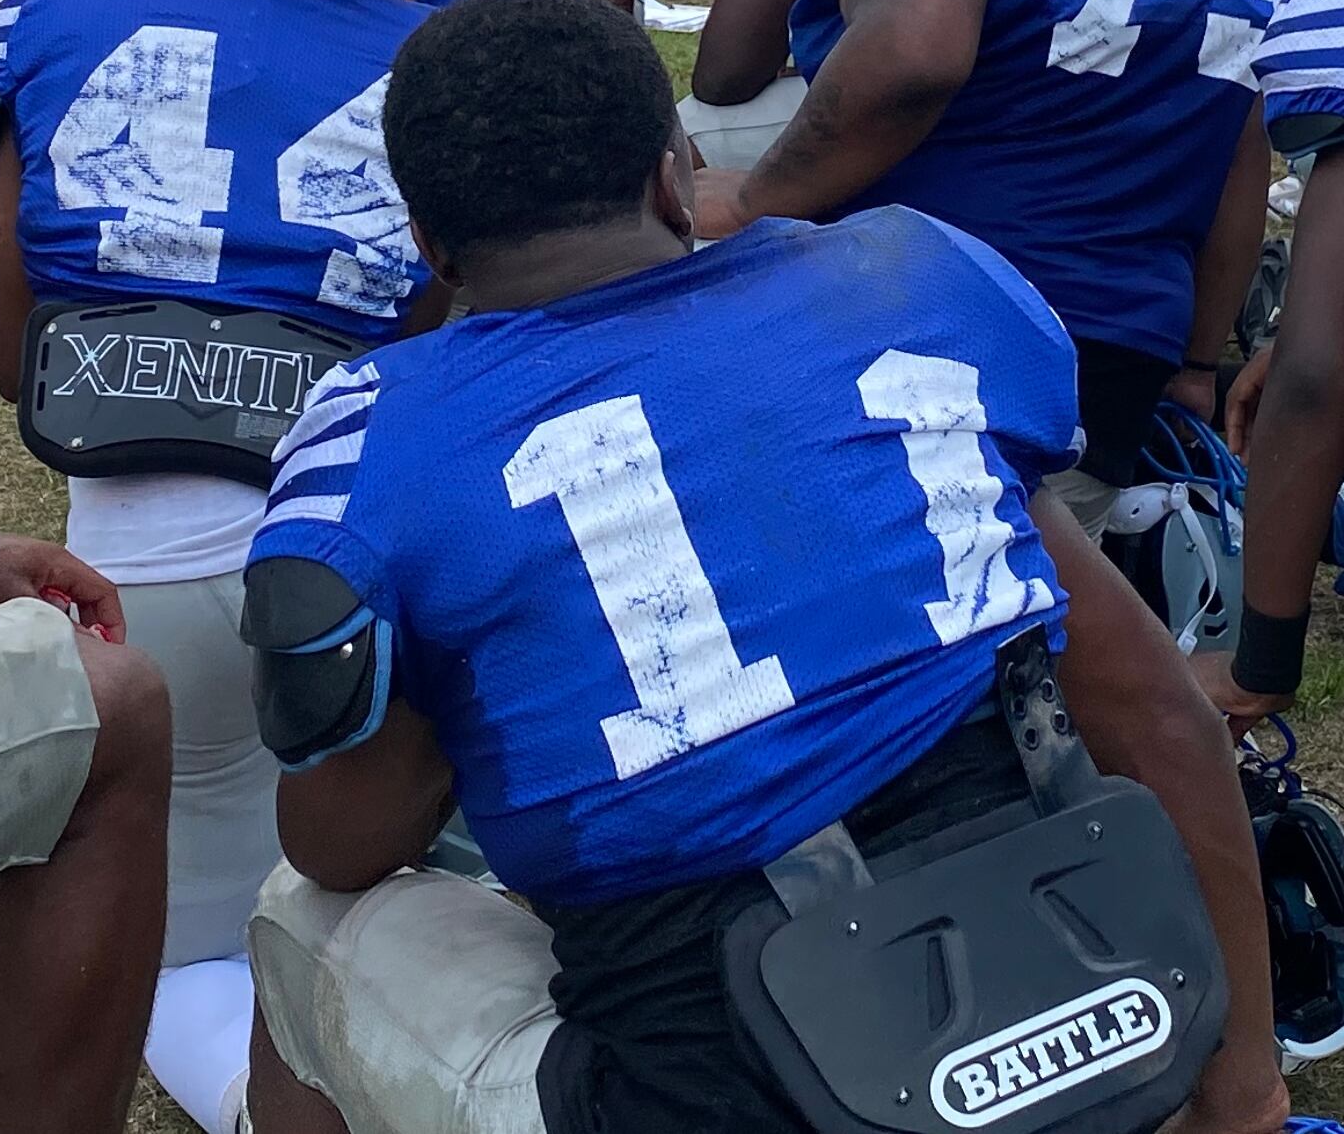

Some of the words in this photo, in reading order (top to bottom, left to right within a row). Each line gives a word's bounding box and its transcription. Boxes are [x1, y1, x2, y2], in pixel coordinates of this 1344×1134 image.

[50, 25, 422, 317] 44
[502, 348, 1055, 780] 11
[953, 992, 1154, 1112] BATTLE
